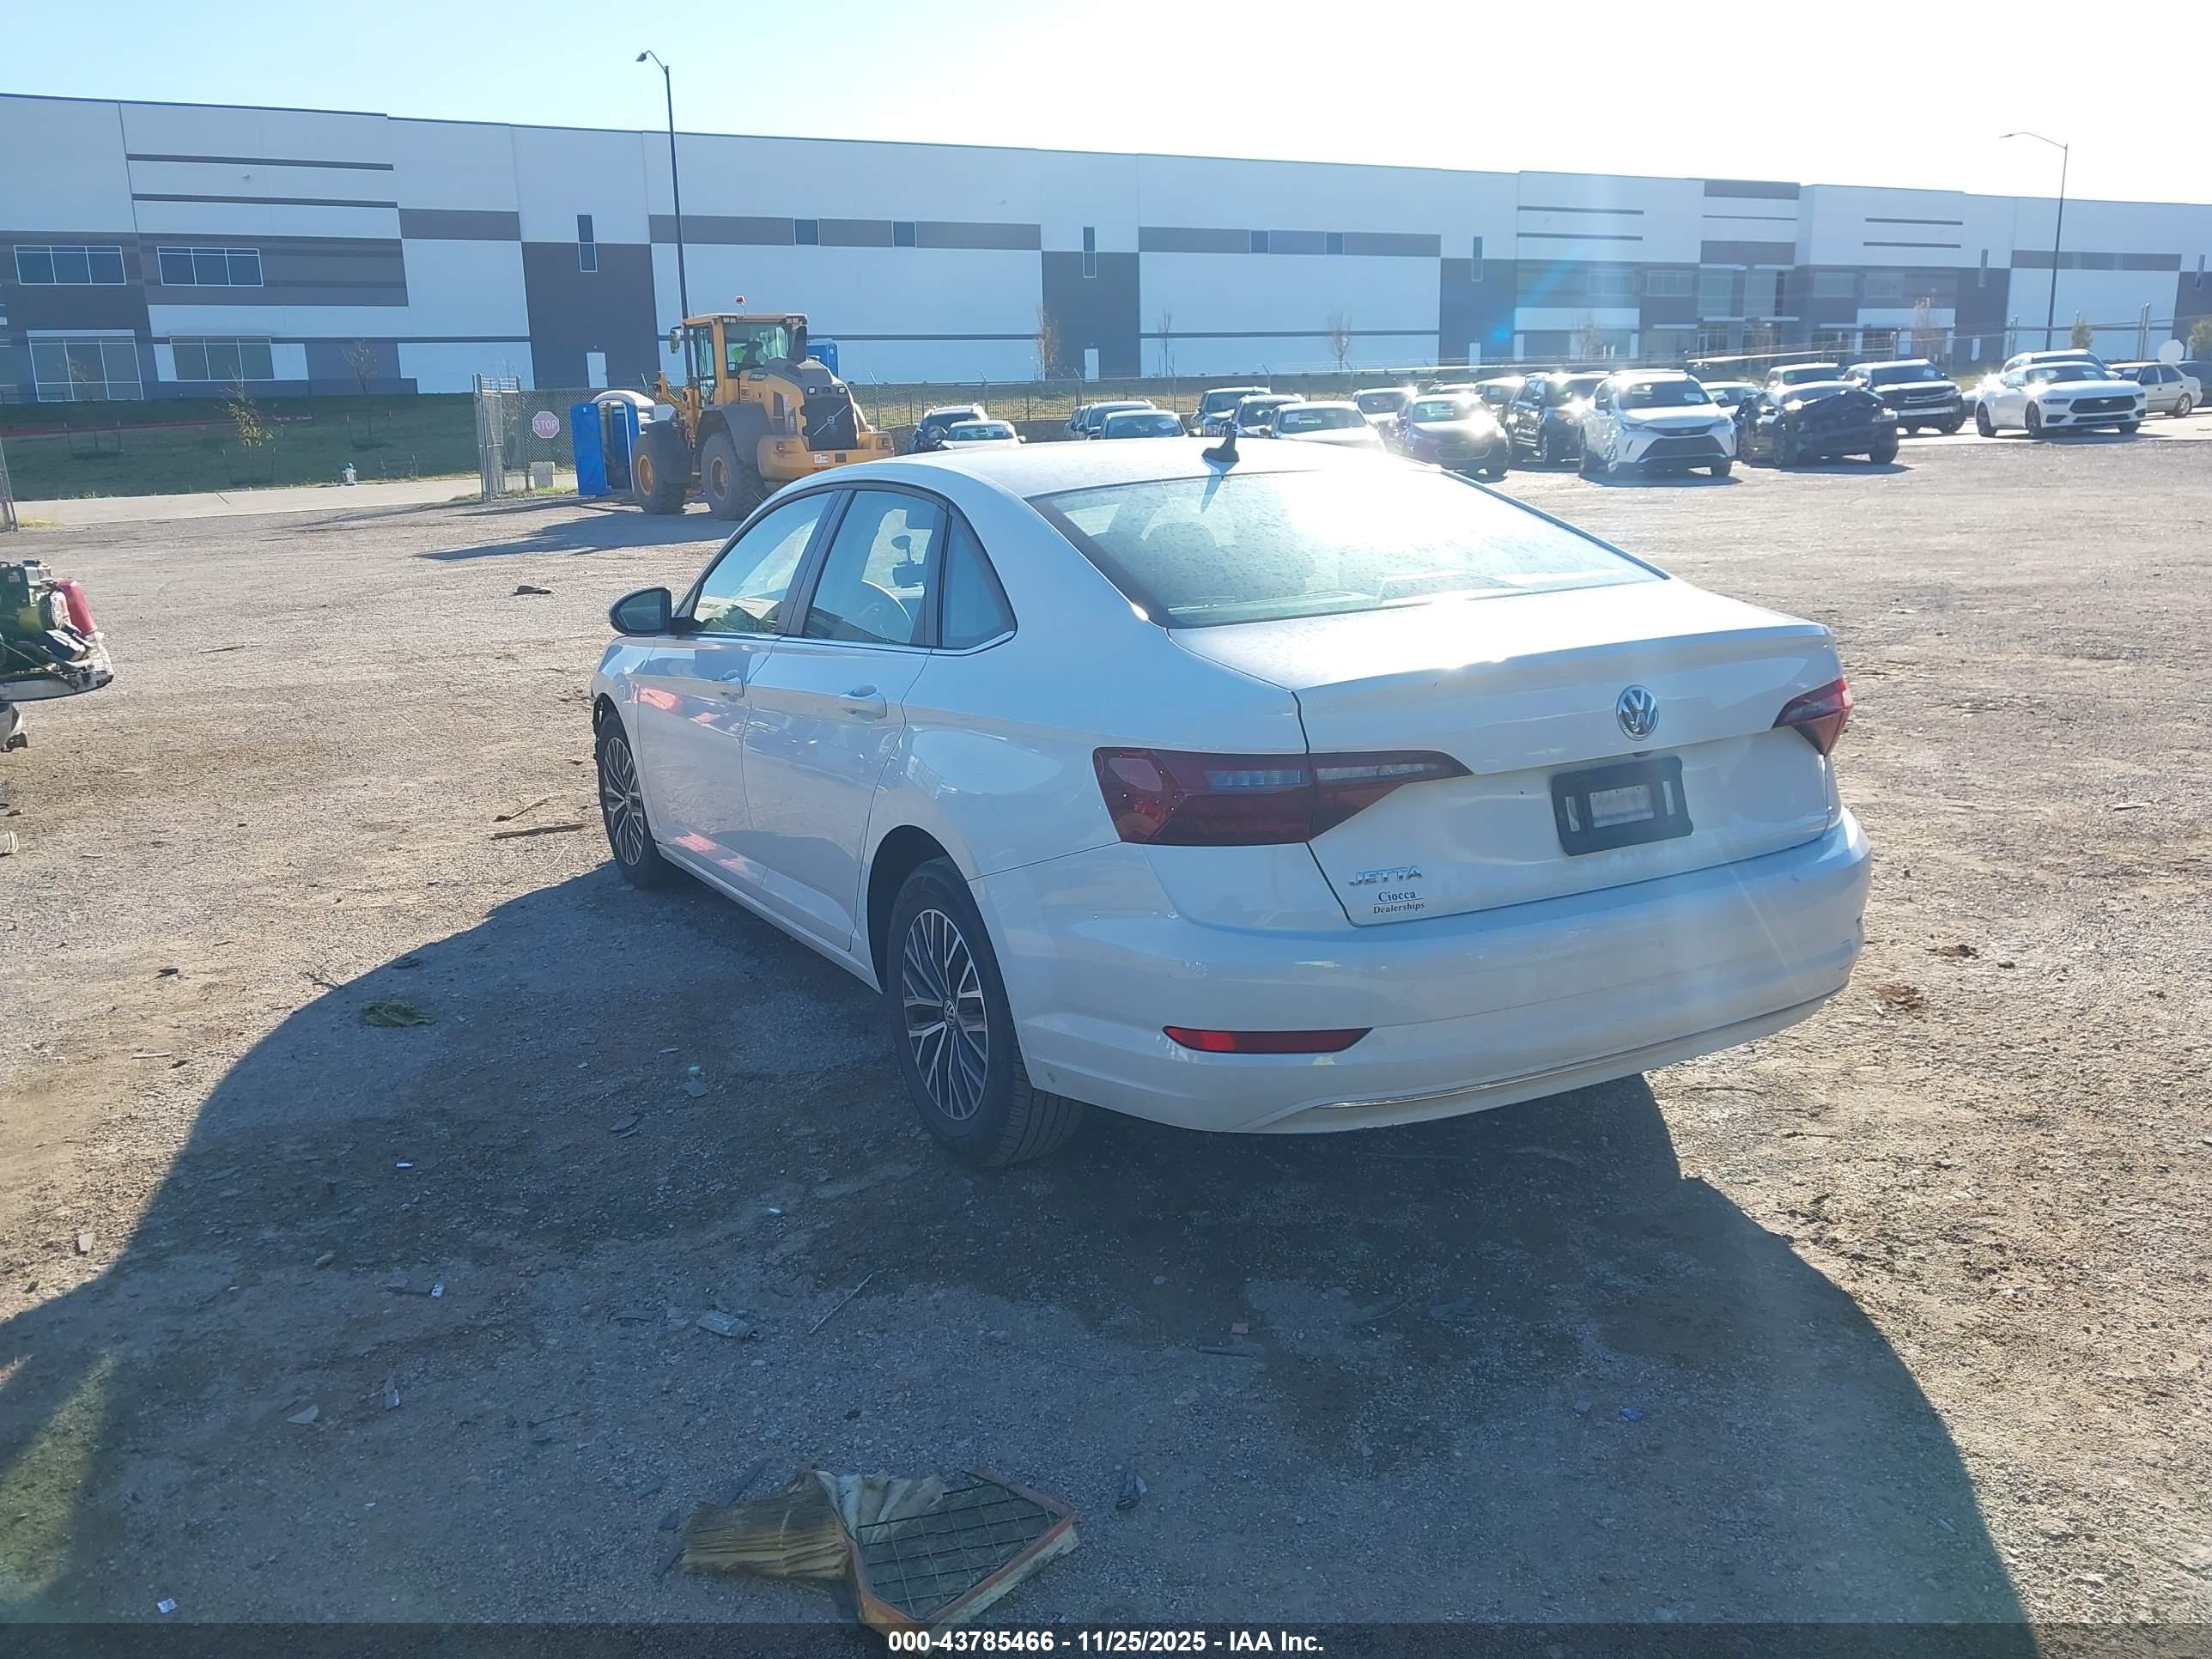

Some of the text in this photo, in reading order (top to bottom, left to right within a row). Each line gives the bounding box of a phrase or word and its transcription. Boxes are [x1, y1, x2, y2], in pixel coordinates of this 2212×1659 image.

[536, 420, 557, 430] STOP
[1348, 866, 1423, 886] JETTA
[1378, 890, 1416, 902] Ciocca
[1373, 902, 1425, 915] Dealerships
